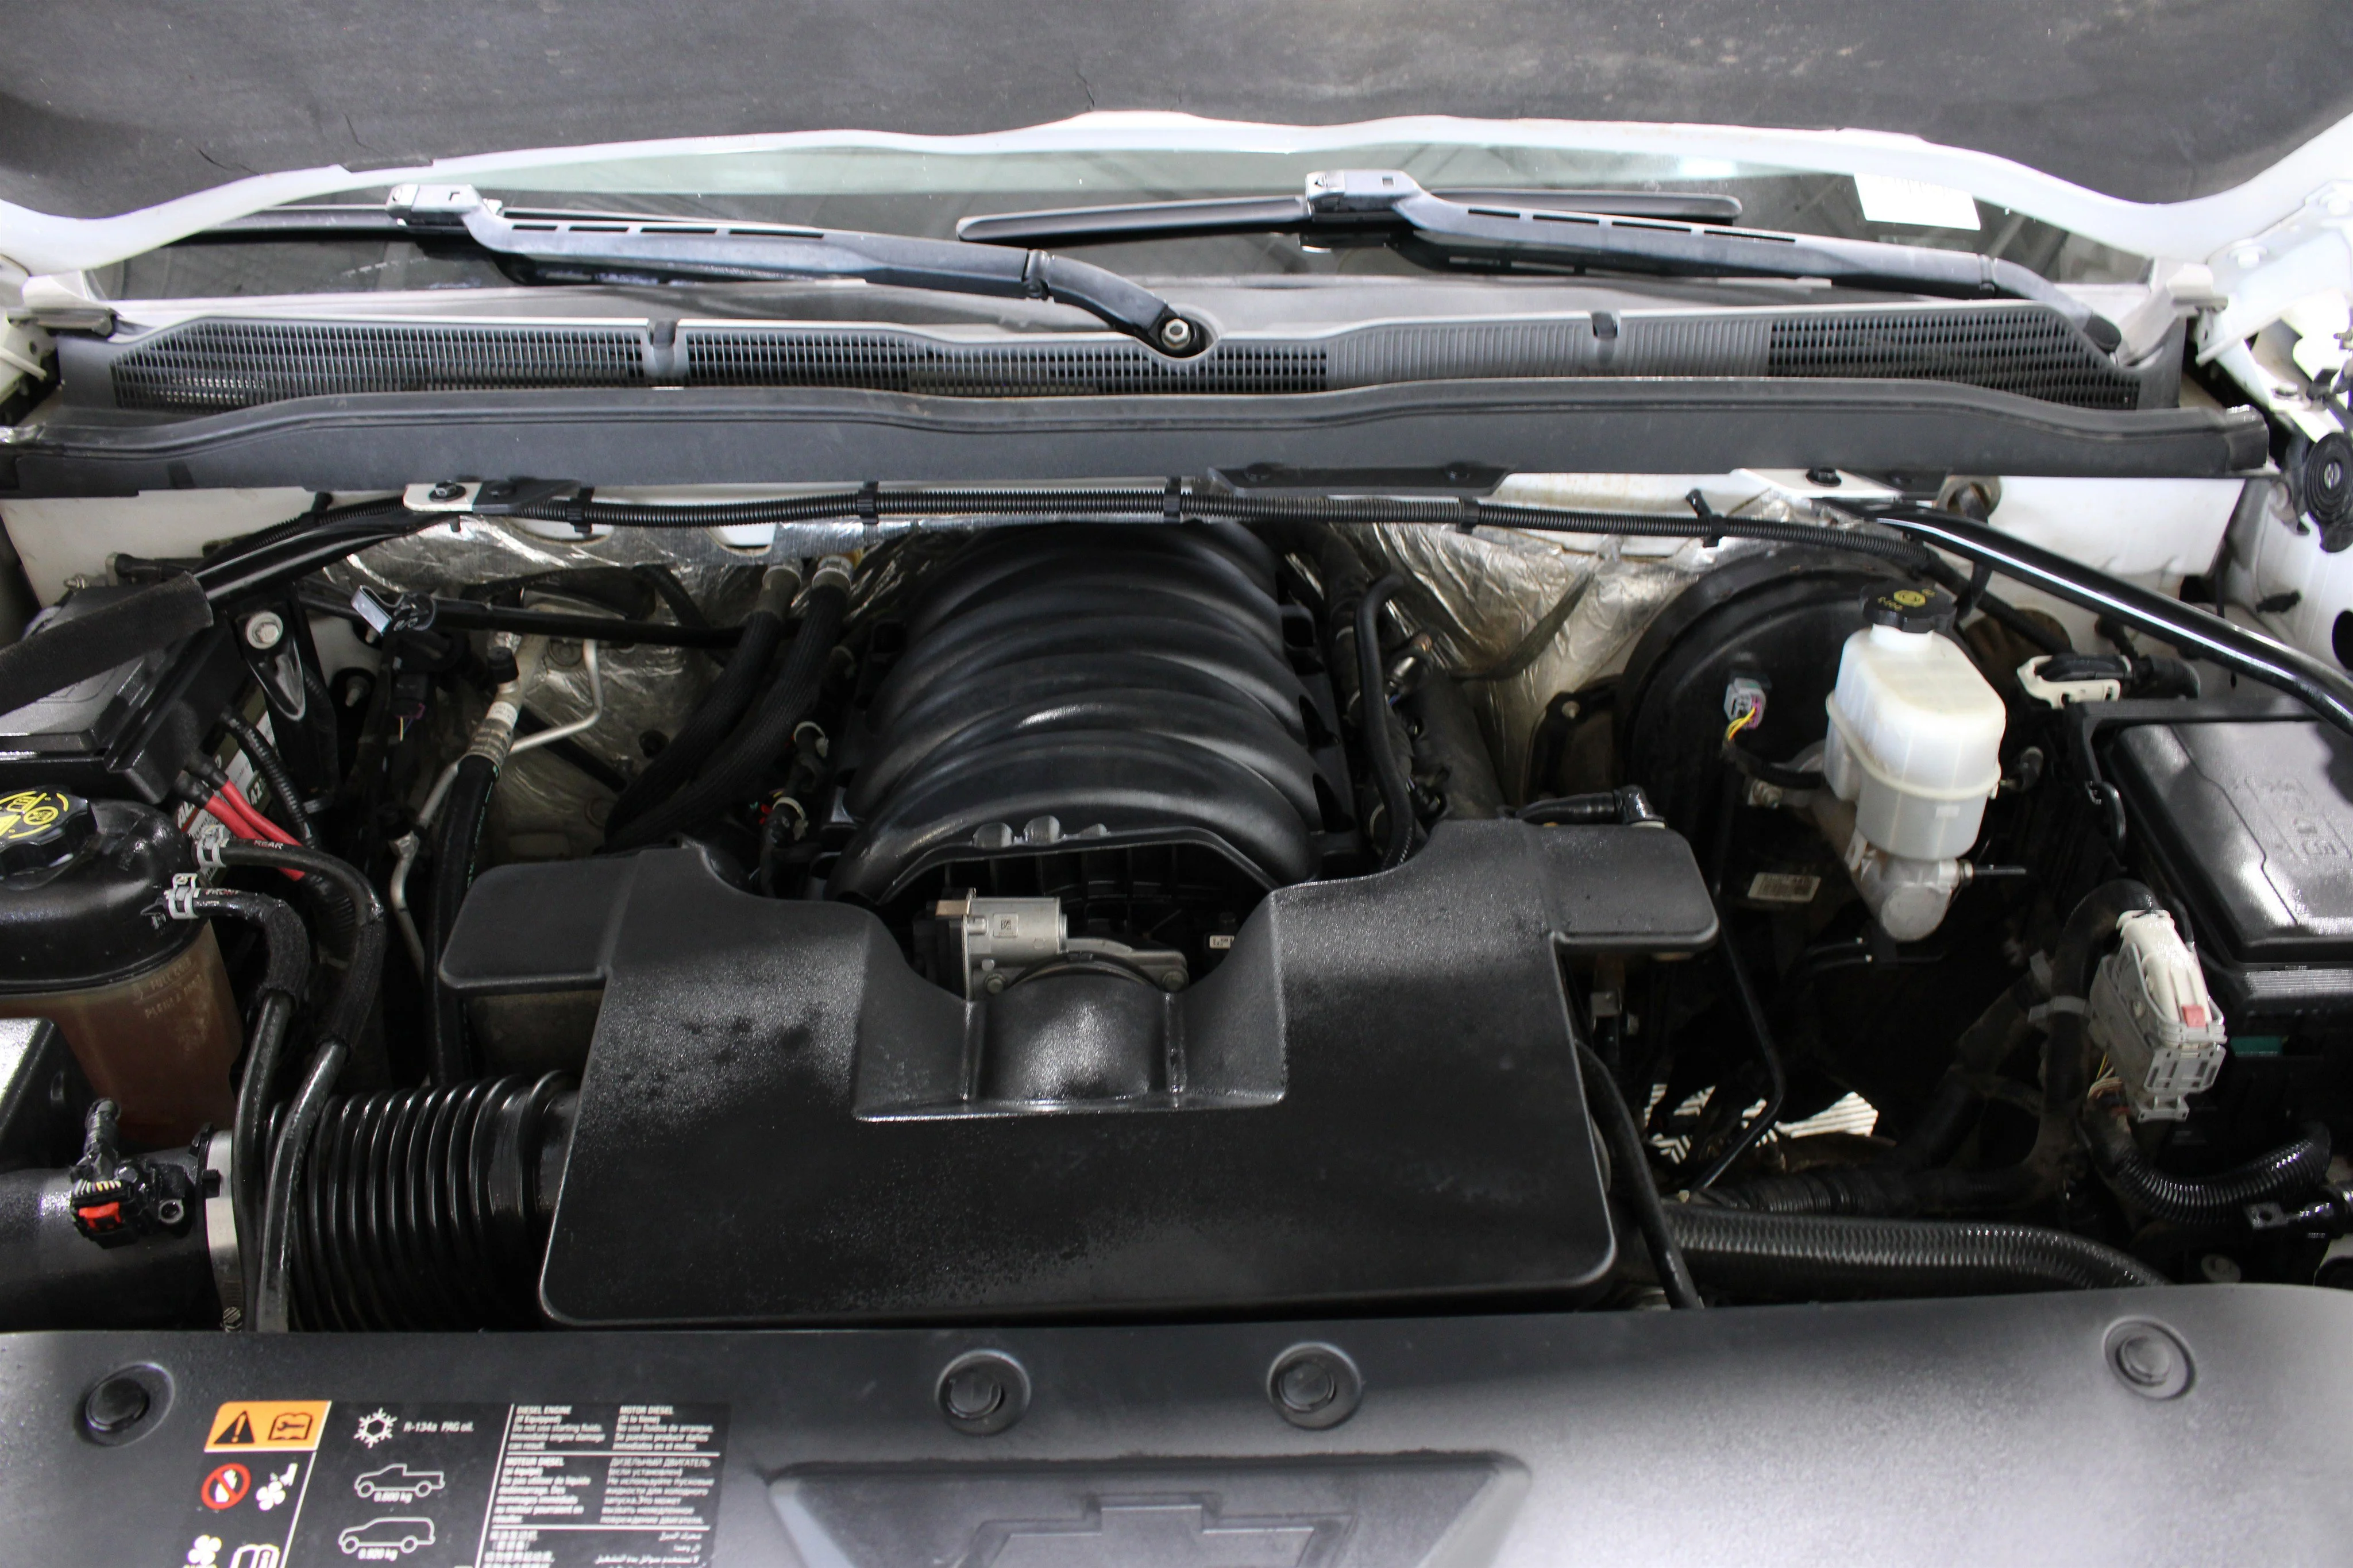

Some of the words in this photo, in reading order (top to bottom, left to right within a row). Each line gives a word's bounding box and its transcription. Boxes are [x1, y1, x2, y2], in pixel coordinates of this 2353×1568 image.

[254, 839, 284, 849] REAR
[516, 1405, 542, 1415] DIESEL
[543, 1405, 572, 1415] ENGINE
[619, 1405, 647, 1415] MOTOR
[647, 1405, 674, 1415] DIESEL
[403, 1422, 438, 1432] R-134a
[441, 1421, 461, 1432] PAG
[512, 1424, 523, 1432] Do
[523, 1424, 537, 1432] not
[551, 1424, 580, 1434] starting
[538, 1457, 565, 1467] DIESEL
[399, 1492, 413, 1504] kg
[384, 1548, 398, 1562] kg
